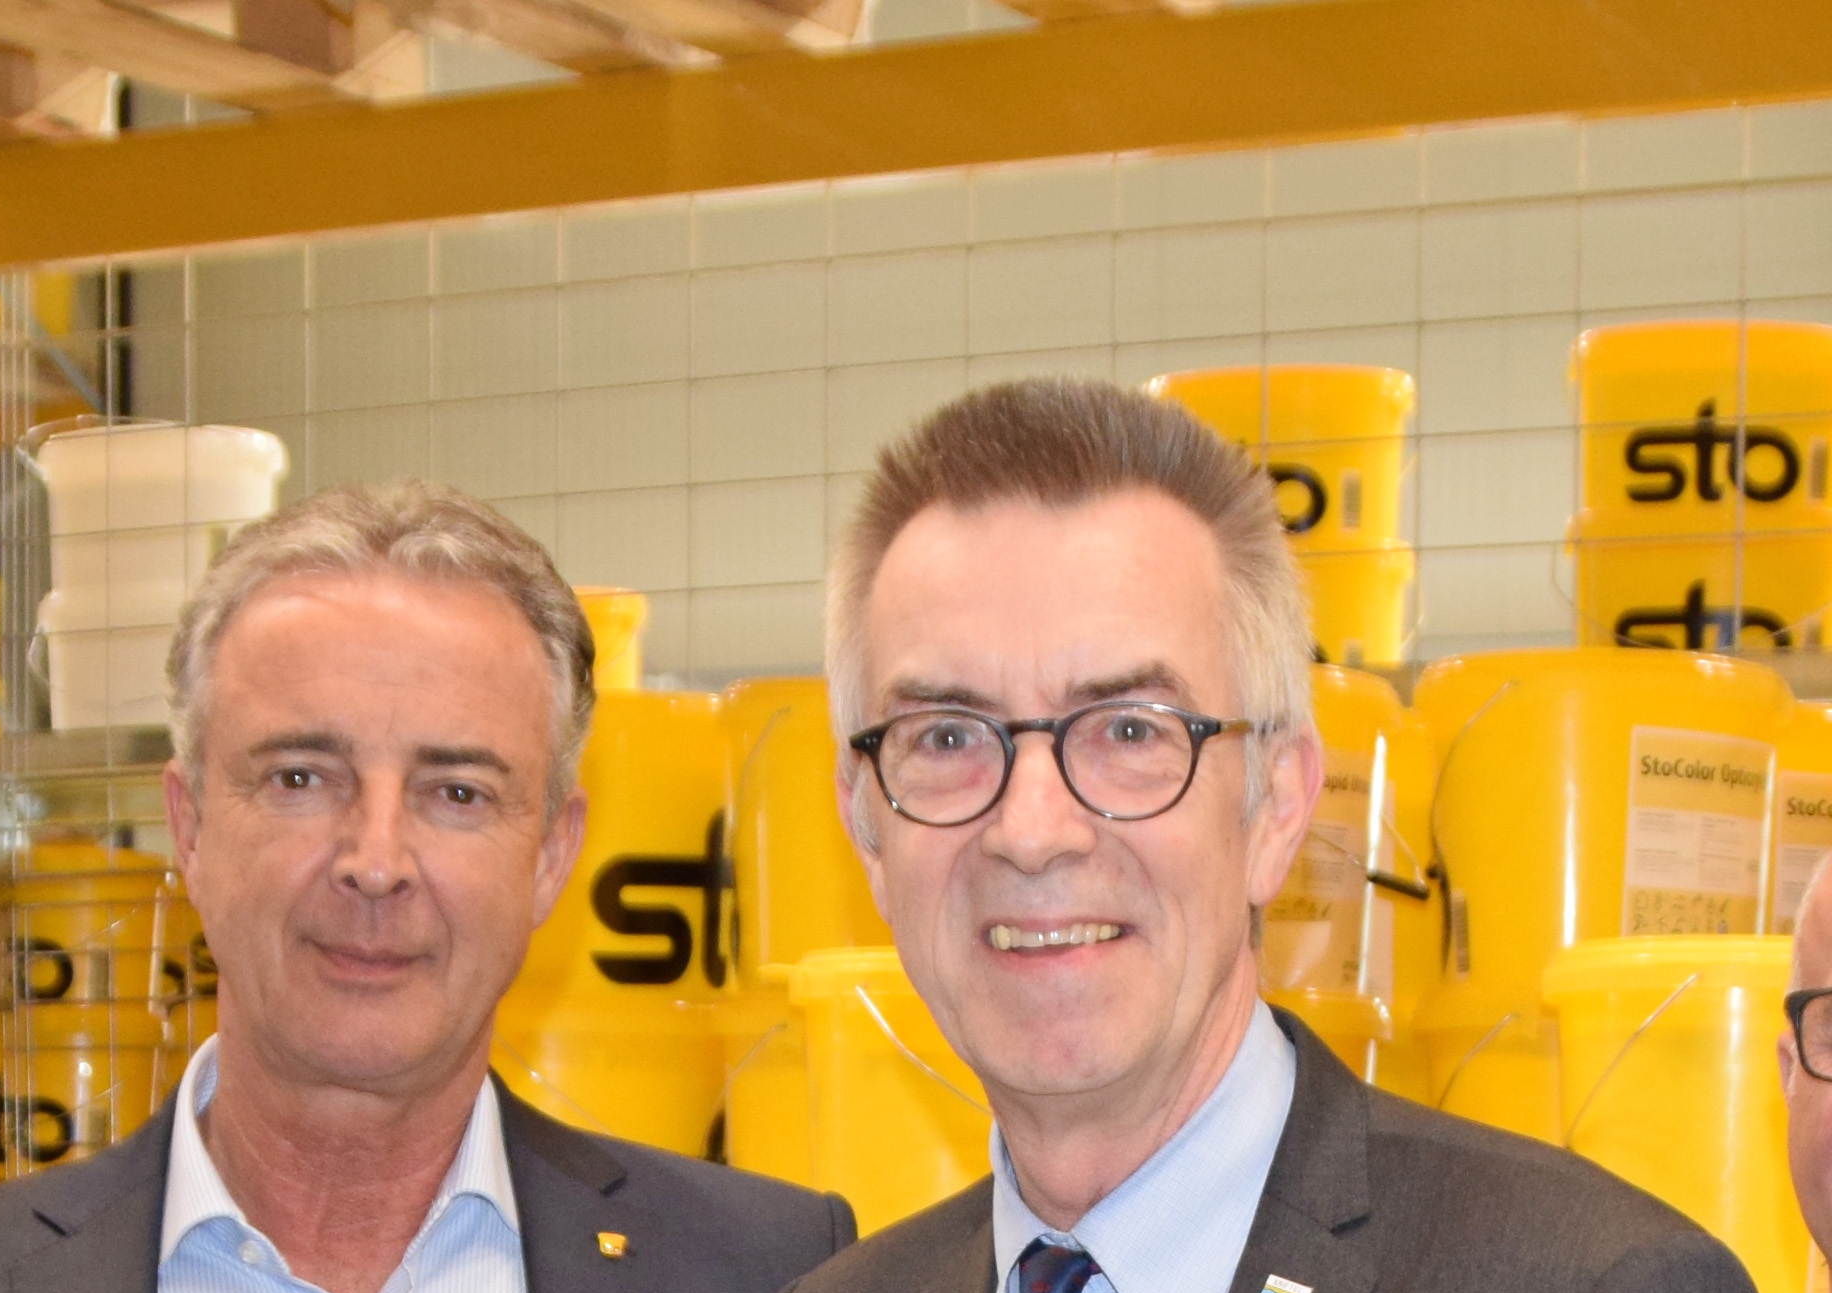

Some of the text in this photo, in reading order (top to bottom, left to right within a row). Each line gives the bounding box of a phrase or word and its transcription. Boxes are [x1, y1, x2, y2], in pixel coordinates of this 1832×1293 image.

[1625, 397, 1801, 503] sto
[1640, 754, 1717, 782] StoColor
[590, 806, 741, 989] st
